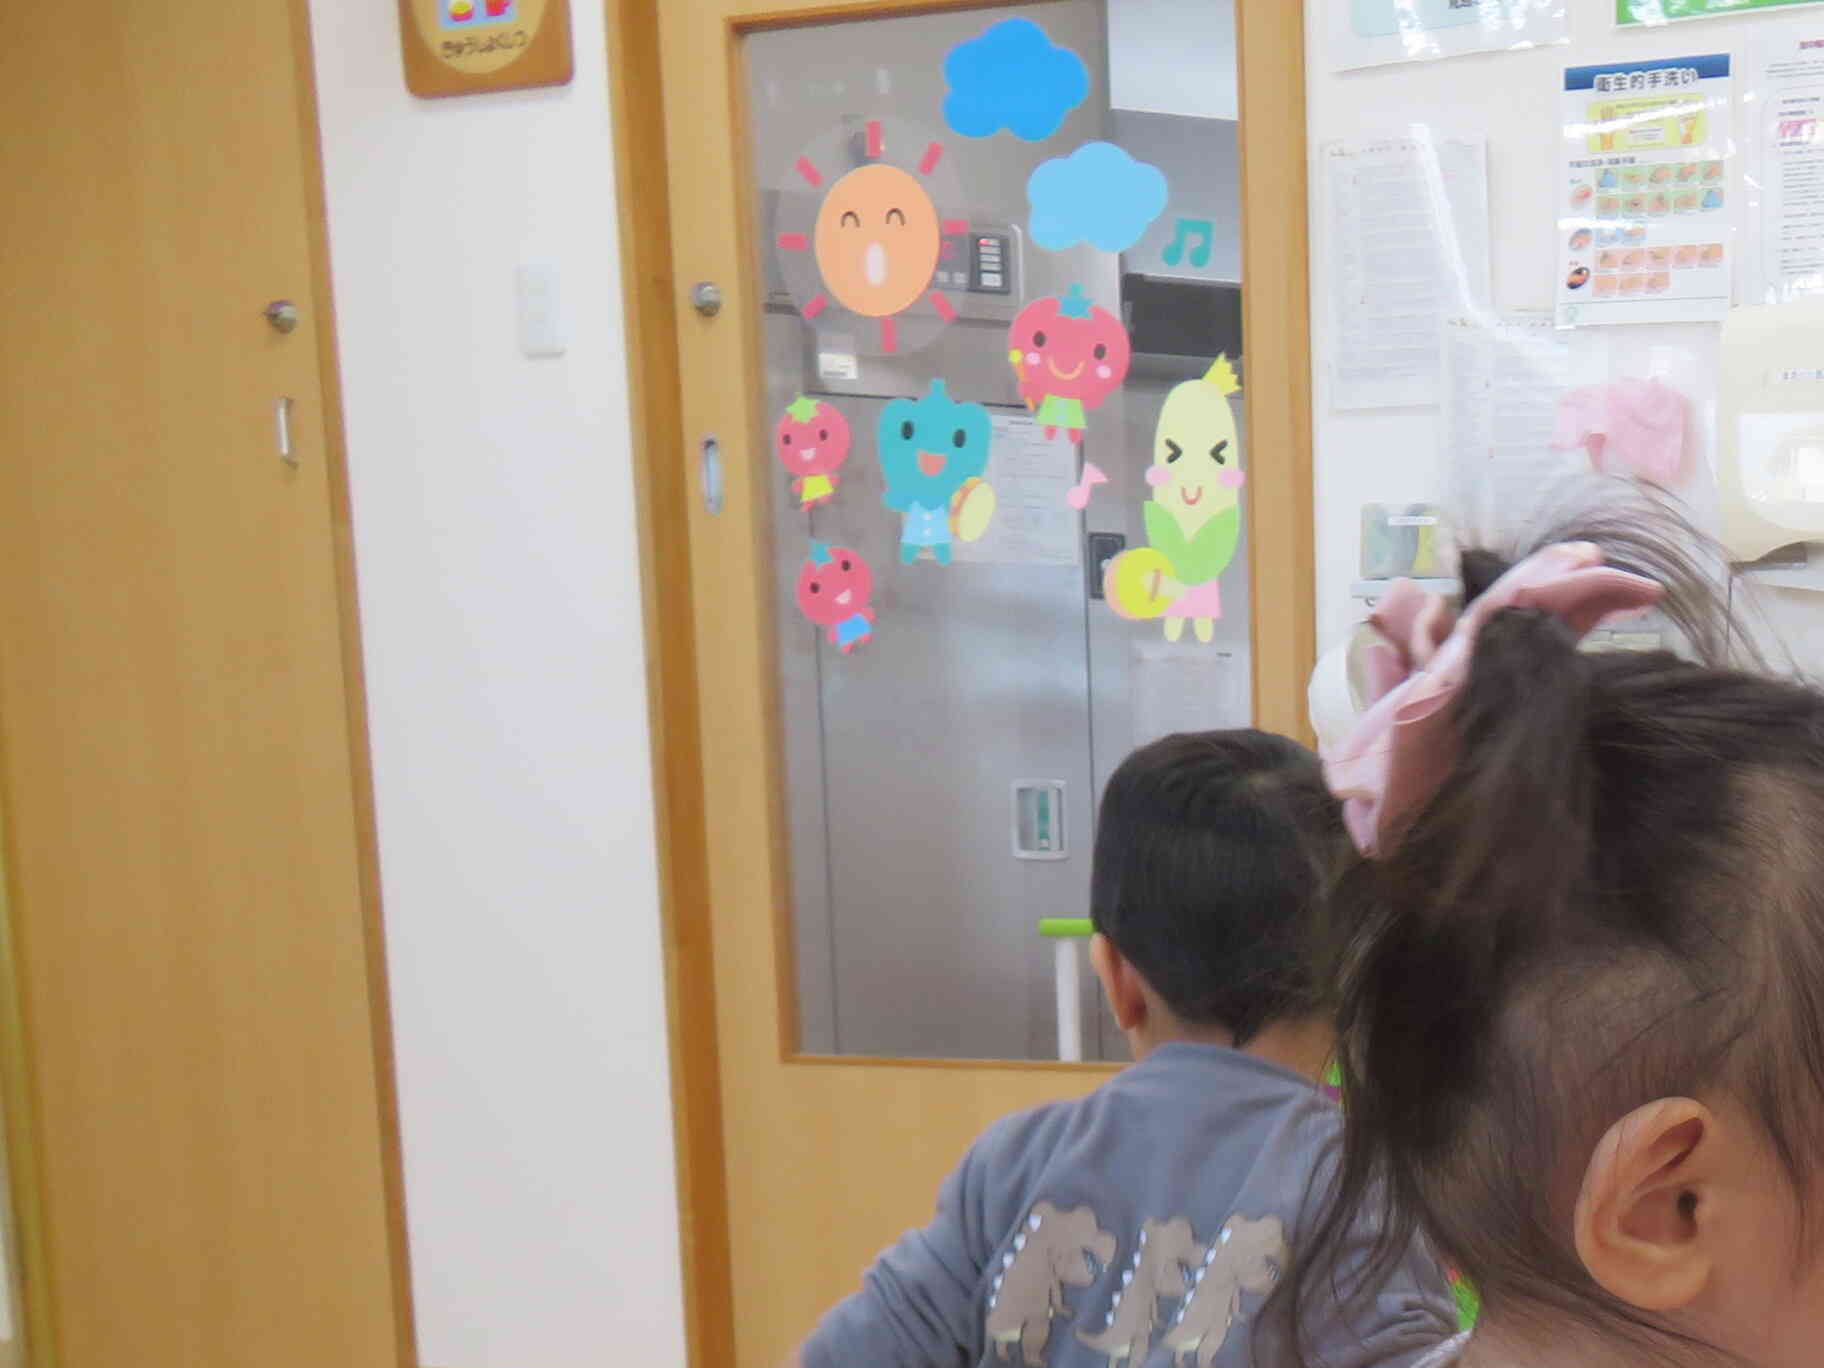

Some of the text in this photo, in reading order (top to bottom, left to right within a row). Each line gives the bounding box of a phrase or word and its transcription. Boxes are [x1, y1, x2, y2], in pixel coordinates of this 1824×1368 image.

[1597, 69, 1698, 93] 衛生的手洗い
